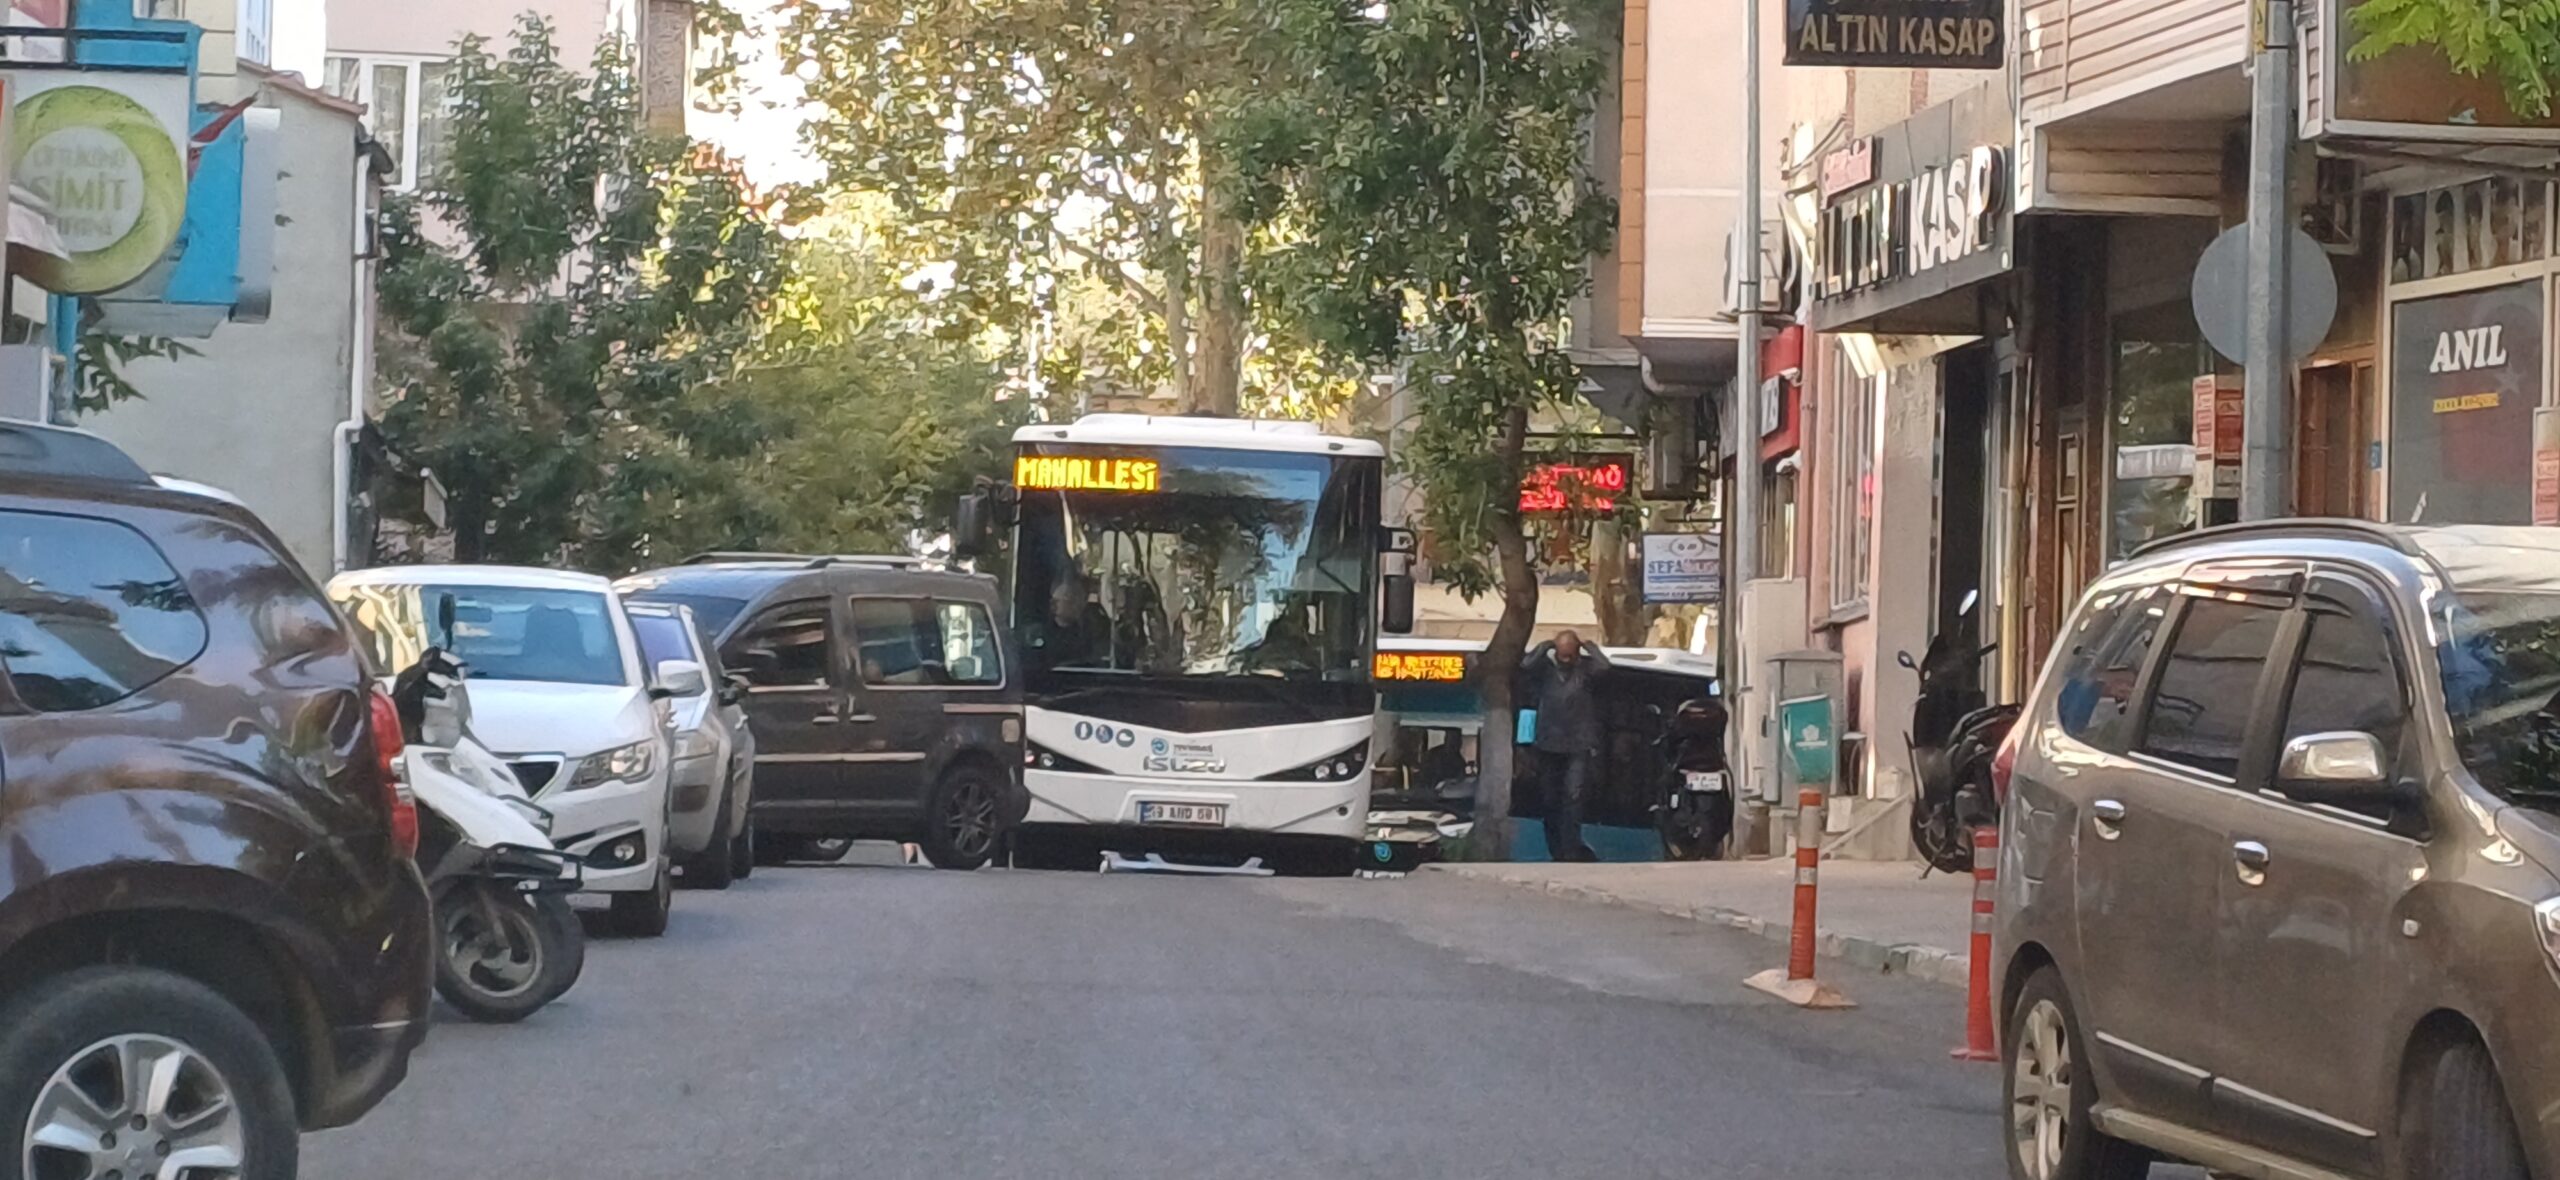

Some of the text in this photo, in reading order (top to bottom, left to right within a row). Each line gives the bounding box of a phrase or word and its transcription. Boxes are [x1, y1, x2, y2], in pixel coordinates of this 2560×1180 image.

[1800, 14, 1995, 56] ALTIN KASAP
[2429, 324, 2507, 373] ANIL
